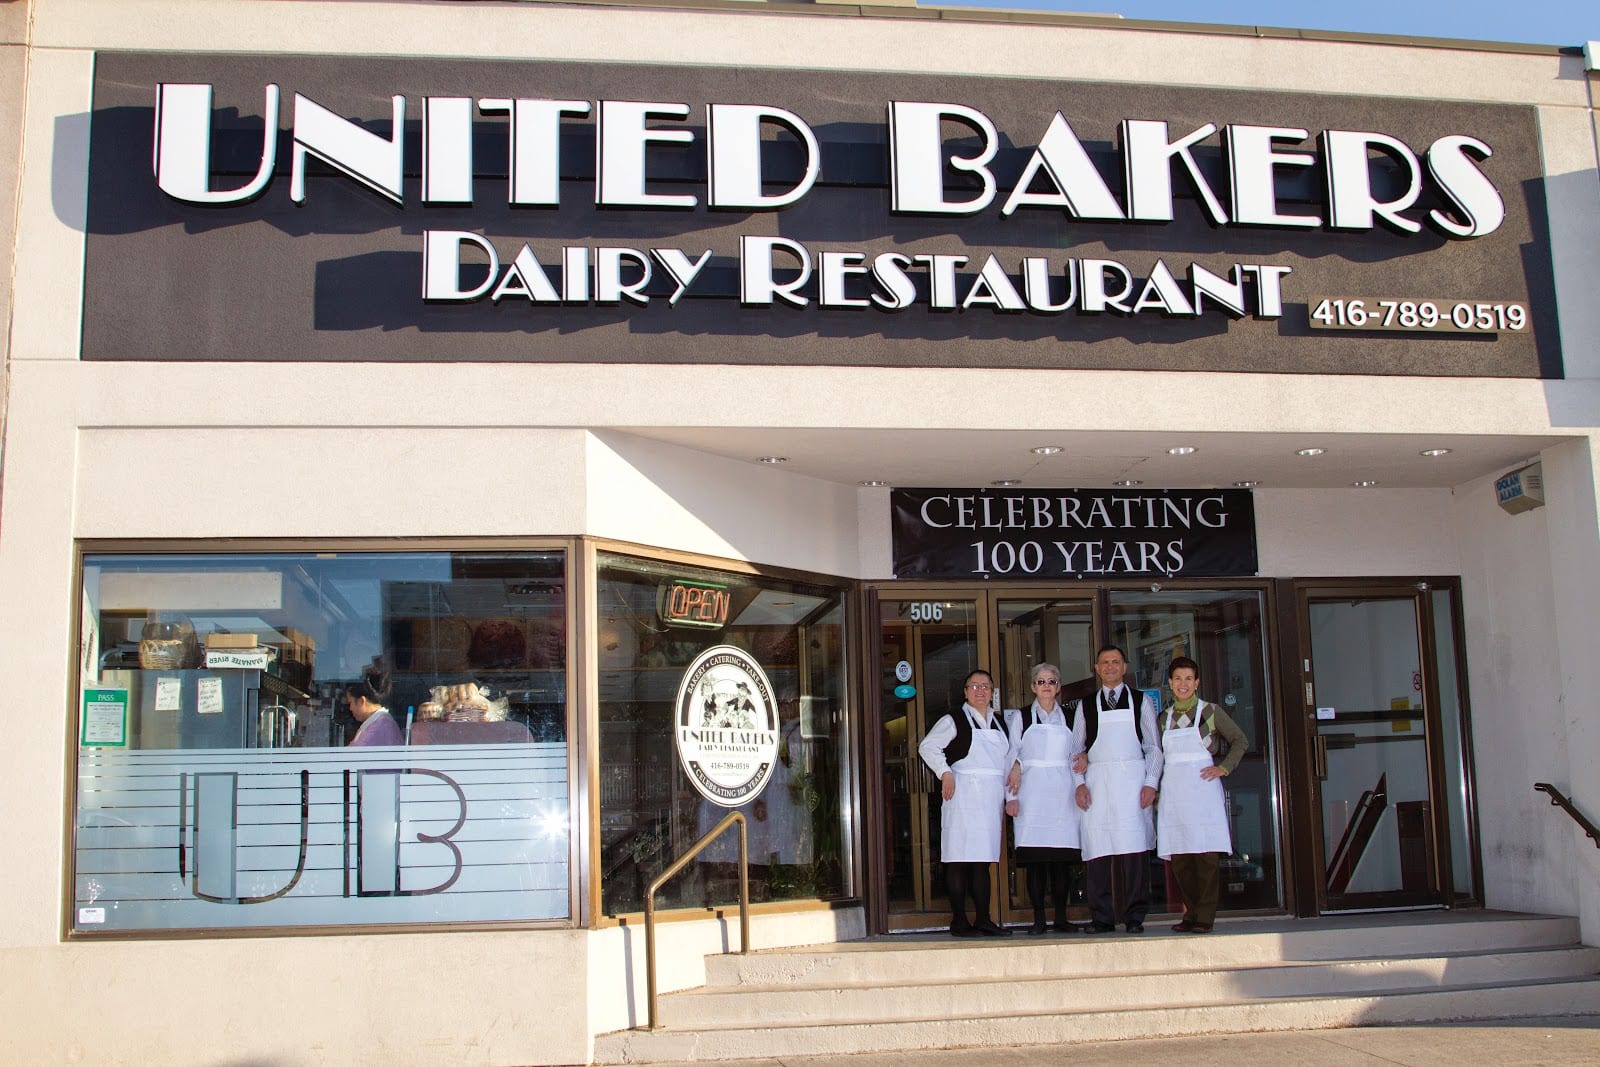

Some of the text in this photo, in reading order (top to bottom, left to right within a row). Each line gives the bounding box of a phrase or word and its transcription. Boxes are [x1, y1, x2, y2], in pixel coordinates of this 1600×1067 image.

[153, 82, 1506, 239] UNITED BAKERS
[422, 230, 1293, 319] DAIRY RESTAURANT
[1311, 299, 1527, 331] 416-789-0519
[920, 493, 1229, 533] CELEBRATING
[969, 538, 1184, 575] 100 YEARS
[670, 585, 731, 622] OPEN
[910, 602, 943, 622] 506
[209, 656, 229, 664] RIVER
[687, 655, 770, 702] BAKERY CATERING TAKE-OUT
[97, 694, 115, 702] PASS
[695, 768, 737, 798] CELEBRATING
[747, 768, 765, 790] YEARS
